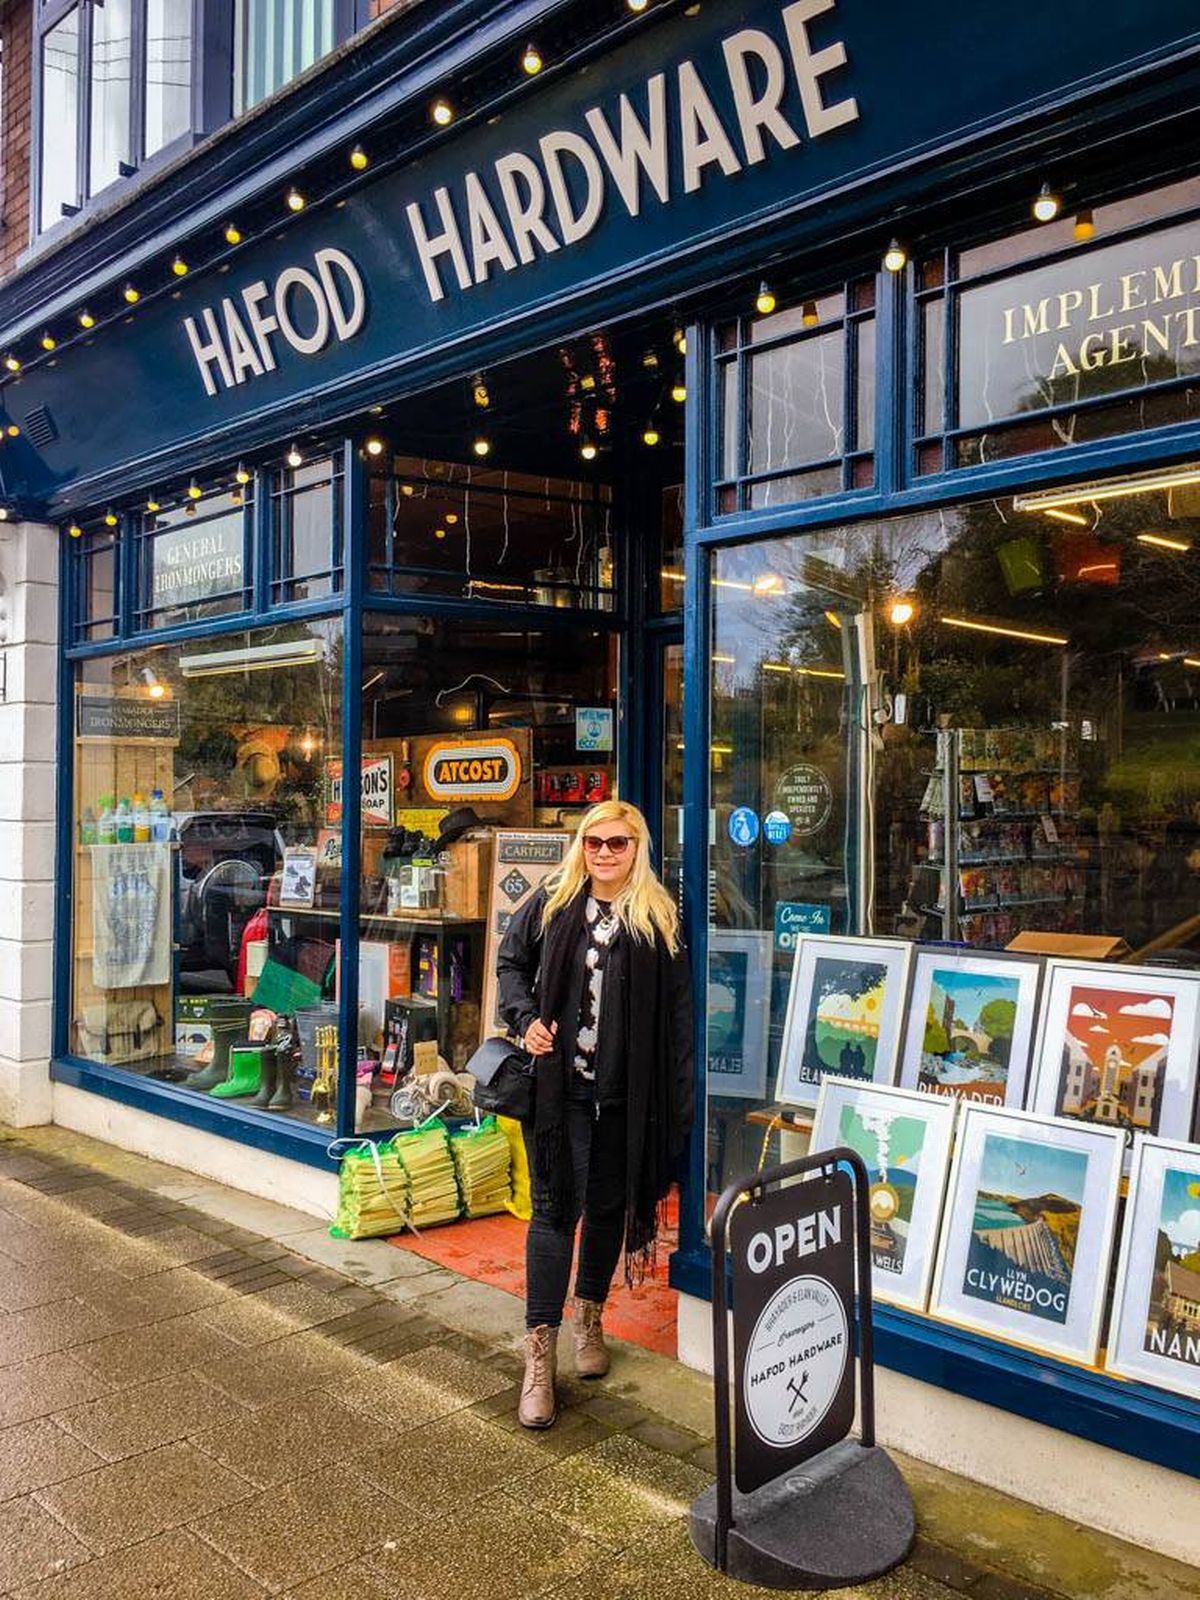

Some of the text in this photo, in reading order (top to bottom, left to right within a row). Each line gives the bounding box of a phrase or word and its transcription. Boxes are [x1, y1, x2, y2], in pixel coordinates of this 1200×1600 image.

[183, 0, 861, 397] HAFOD HARDWARE
[167, 534, 224, 565] GENERAL
[155, 554, 242, 593] IRONMONGERS
[439, 760, 502, 782] ATCOST
[504, 878, 524, 894] 65
[746, 1204, 841, 1274] OPEN
[966, 1268, 1066, 1312] CLYWEDOG
[1006, 1267, 1028, 1282] LLYN
[750, 1361, 786, 1387] HAFOD
[788, 1332, 843, 1367] HARDWARE
